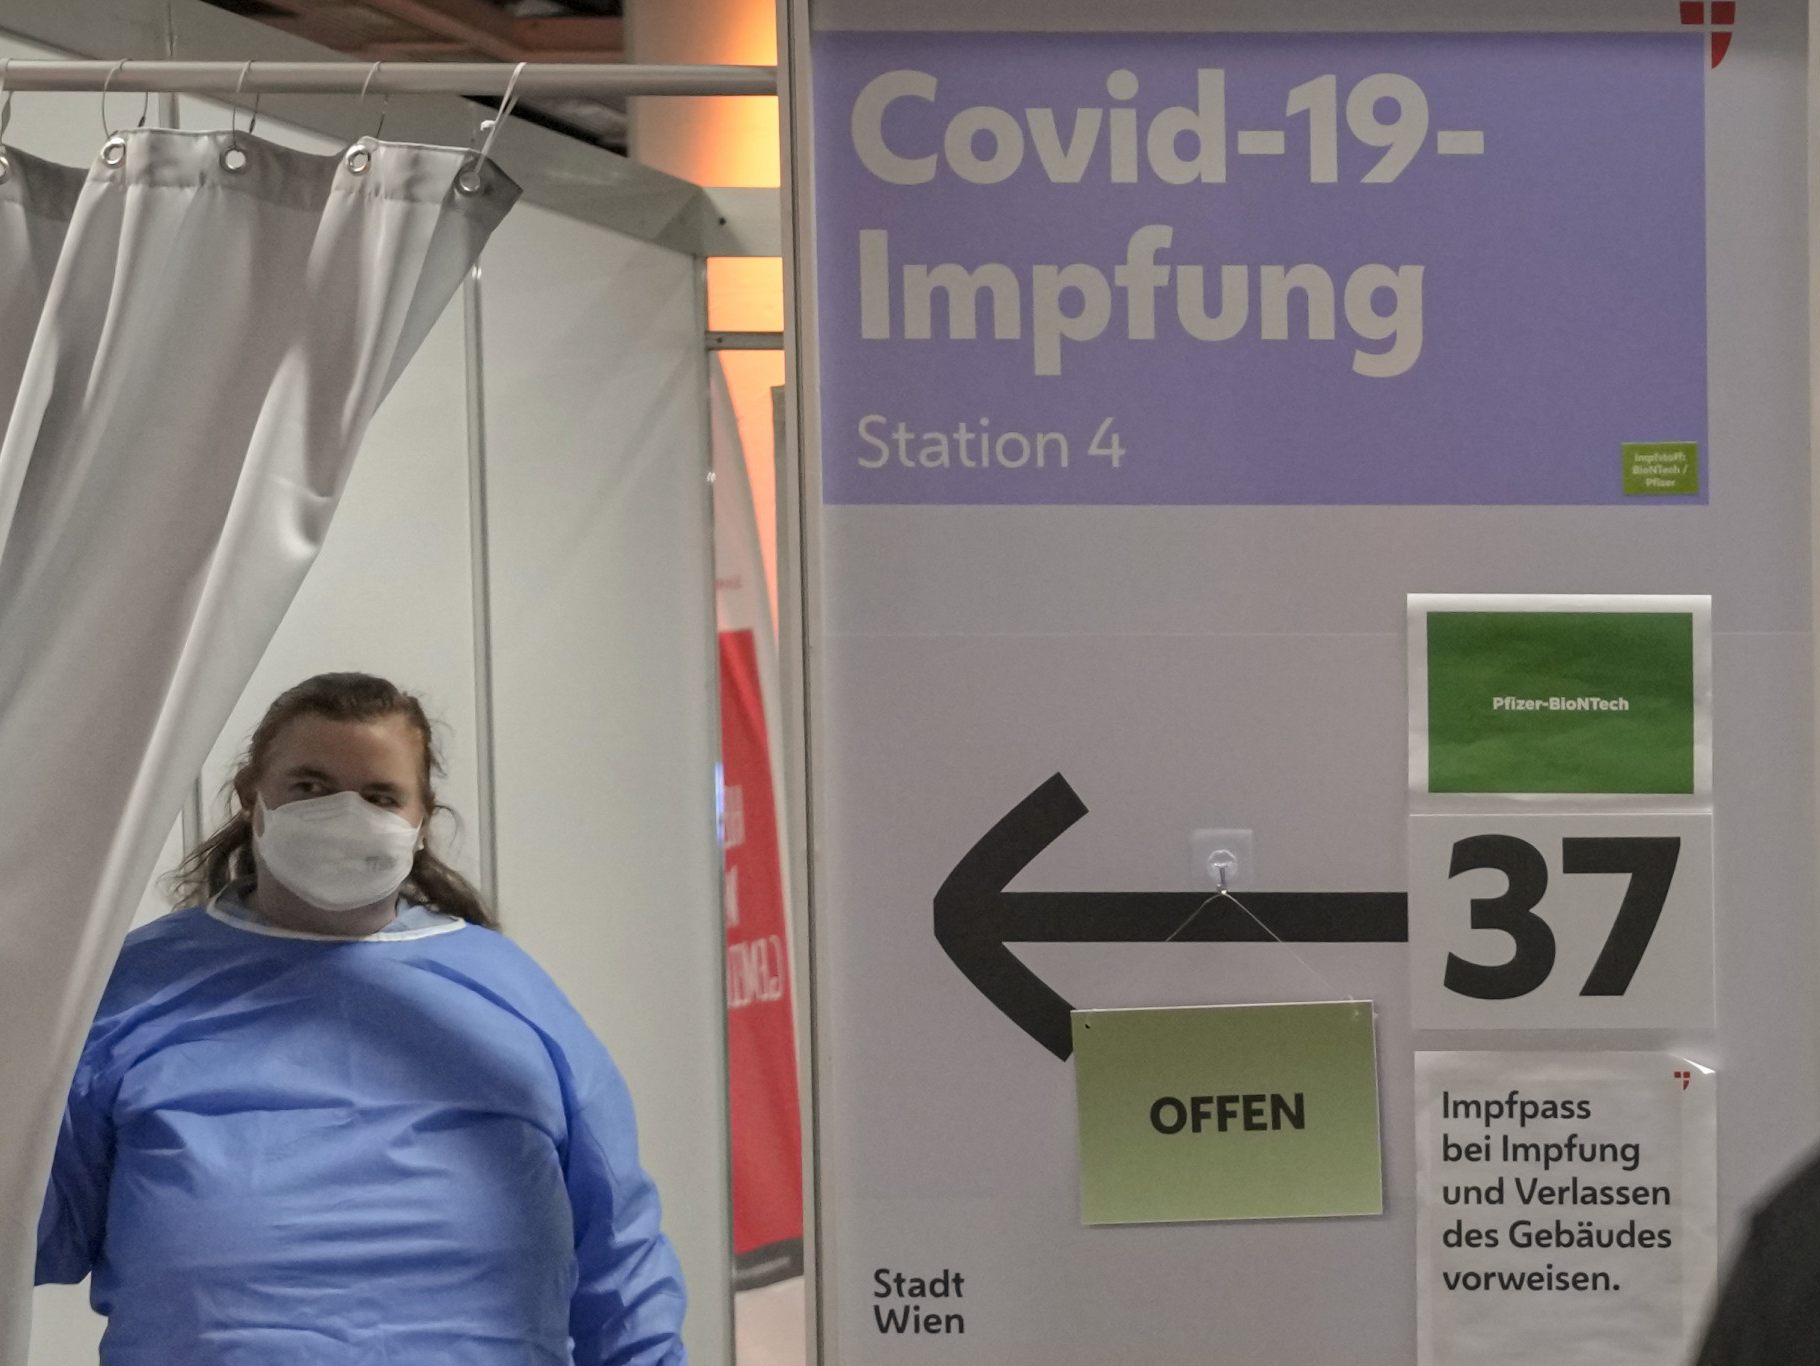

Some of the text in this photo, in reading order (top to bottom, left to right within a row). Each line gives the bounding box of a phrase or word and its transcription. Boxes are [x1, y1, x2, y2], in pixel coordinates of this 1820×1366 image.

[851, 68, 1485, 186] Covid-19-
[859, 224, 1425, 378] Impfung
[858, 414, 1126, 469] Station 4
[1492, 696, 1630, 711] Pfizer-BioNTech
[1443, 834, 1681, 1001] 37
[1149, 1092, 1306, 1135] OFFEN
[1442, 1090, 1591, 1128] Impfpass
[1442, 1133, 1640, 1172] bei Impfung
[1442, 1176, 1671, 1206] und Verlassen
[1442, 1219, 1672, 1249] des Gebäudes
[873, 1268, 965, 1299] Stadt
[1442, 1263, 1620, 1291] vorweisen.
[873, 1304, 965, 1334] Wien
